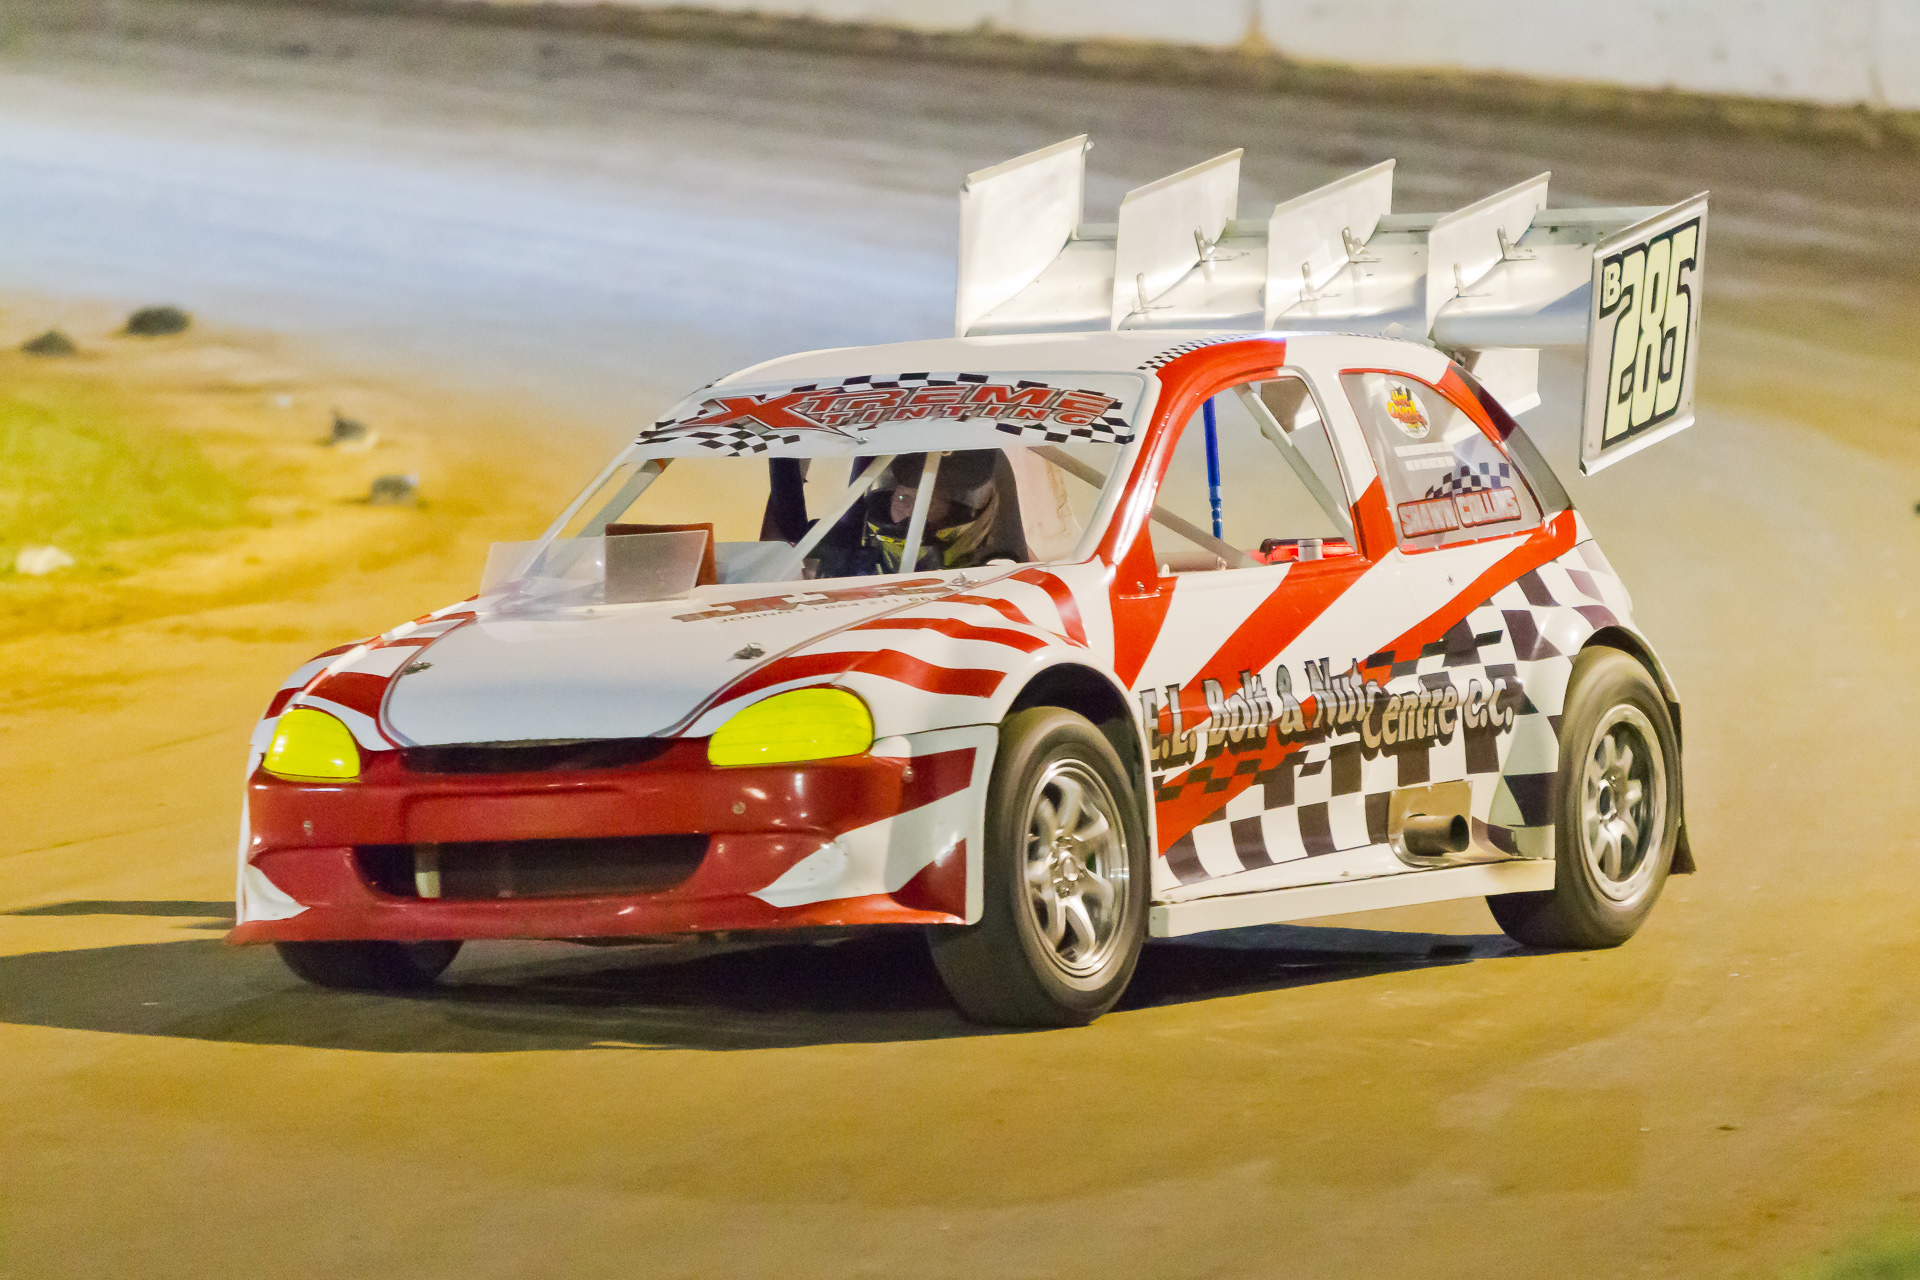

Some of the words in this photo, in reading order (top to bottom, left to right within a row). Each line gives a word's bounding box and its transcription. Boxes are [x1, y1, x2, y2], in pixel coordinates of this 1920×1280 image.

[1602, 259, 1621, 311] B
[1603, 220, 1699, 445] 285
[684, 384, 1117, 430] XTREME
[821, 403, 1099, 427] TINTING
[1201, 668, 1272, 750] Bolt
[1276, 664, 1306, 741] &
[1304, 656, 1367, 728] Nut
